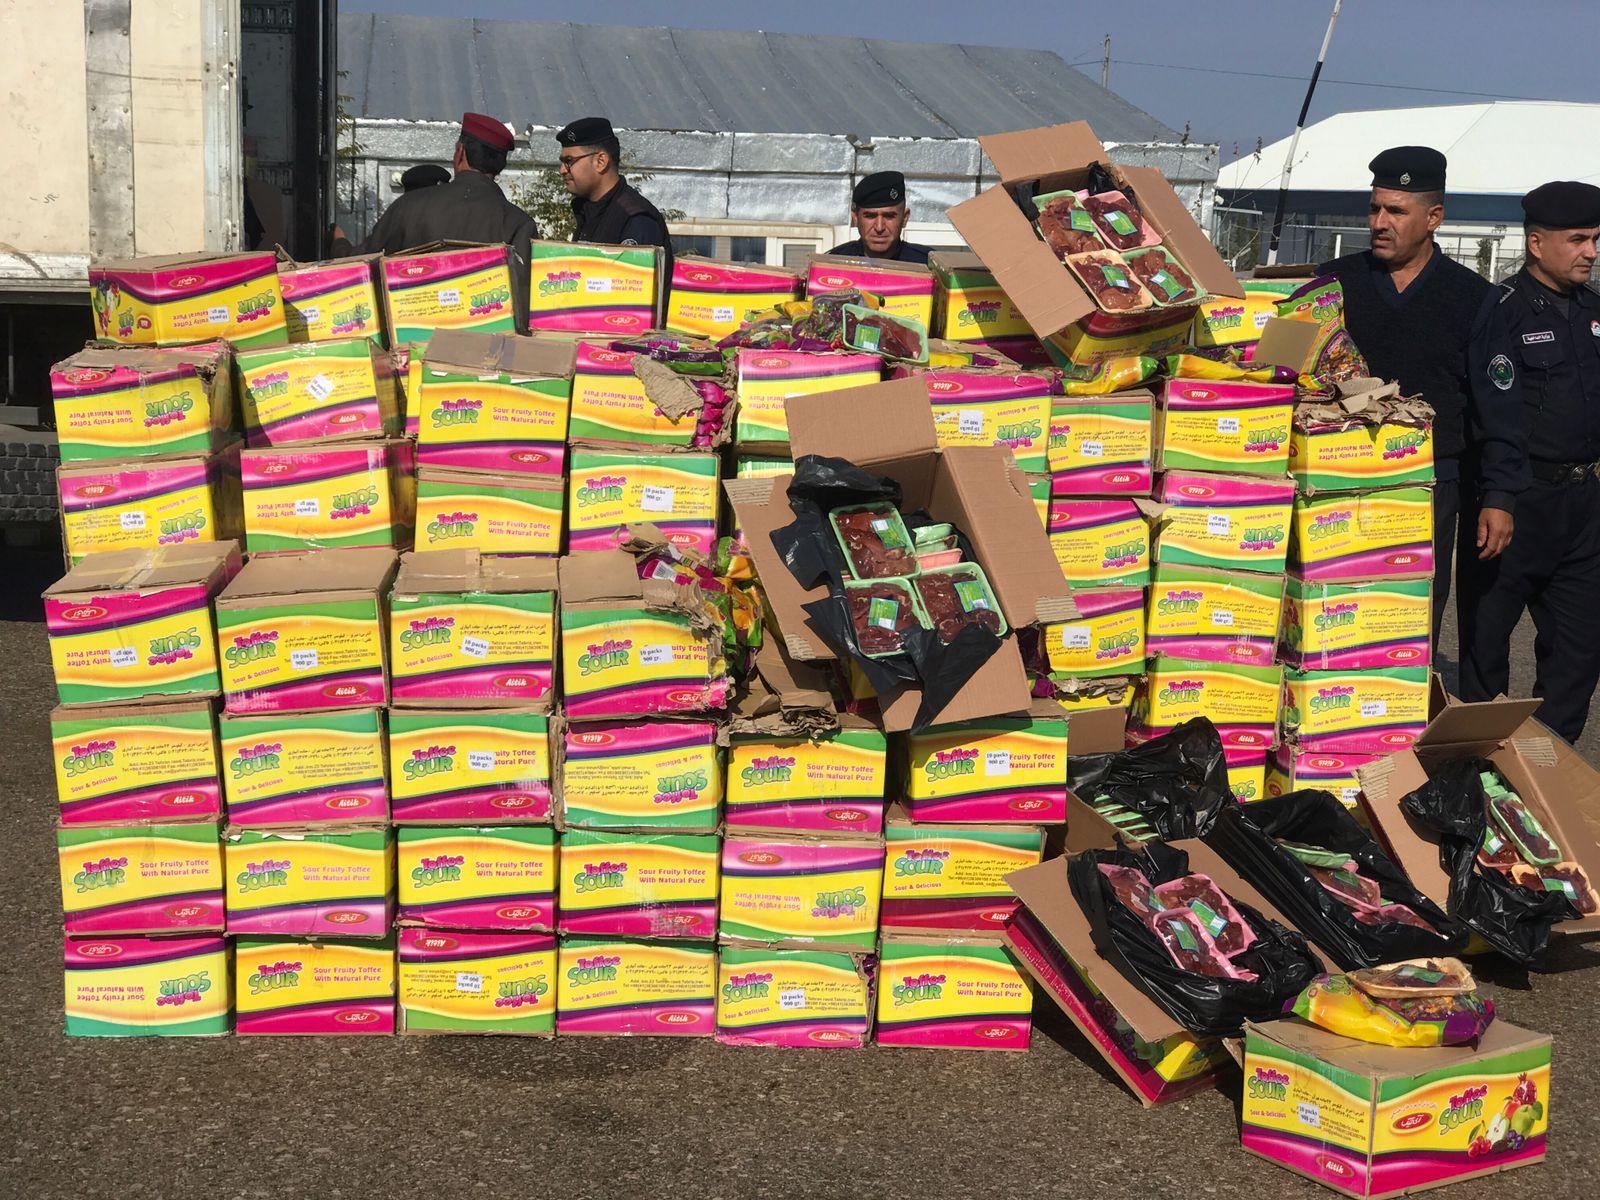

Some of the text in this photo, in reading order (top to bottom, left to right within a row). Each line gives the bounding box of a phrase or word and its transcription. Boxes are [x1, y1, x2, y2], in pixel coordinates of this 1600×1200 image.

[145, 391, 194, 417] SOUR
[431, 408, 479, 428] SOUR
[577, 485, 623, 506] SOUR
[160, 509, 206, 535] SOUR
[427, 521, 474, 542] SOUR
[670, 535, 689, 543] Aitik
[409, 617, 455, 632] Toffee
[150, 627, 201, 654] SOUR
[233, 630, 280, 648] Toffee
[400, 628, 451, 652] SOUR
[225, 643, 277, 668] SOUR
[577, 650, 629, 676] SOUR
[336, 687, 357, 695] Aitik
[506, 678, 527, 686] Aitik
[71, 740, 117, 756] Toffee
[238, 743, 284, 757] Toffee
[935, 748, 979, 762] Toffee
[62, 752, 114, 777] SOUR
[230, 755, 280, 779] SOUR
[403, 756, 454, 781] SOUR
[752, 756, 796, 770] Toffee
[827, 764, 849, 773] Fruity
[925, 759, 975, 782] SOUR
[657, 770, 708, 792] SOUR
[741, 766, 790, 788] SOUR
[174, 795, 194, 804] Aitik
[185, 859, 209, 867] Toffee
[421, 855, 465, 870] Toffee
[496, 861, 518, 869] Fruity
[74, 868, 126, 894] SOUR
[237, 870, 288, 894] SOUR
[412, 865, 462, 888] SOUR
[574, 872, 623, 894] SOUR
[259, 962, 303, 977] Toffee
[334, 967, 356, 975] Fruity
[577, 956, 621, 971] Toffee
[160, 971, 211, 993] SOUR
[249, 972, 299, 995] SOUR
[500, 974, 549, 997] SOUR
[568, 966, 616, 988] SOUR
[902, 973, 947, 987] Toffee
[977, 981, 998, 989] Fruity
[722, 982, 769, 1005] SOUR
[894, 983, 942, 1006] SOUR
[1005, 990, 1022, 998] Pure
[667, 1013, 688, 1022] Aitik
[1247, 1075, 1287, 1101] SOUR
[1439, 1099, 1483, 1135] SOUR
[1326, 1160, 1343, 1173] Aitik
